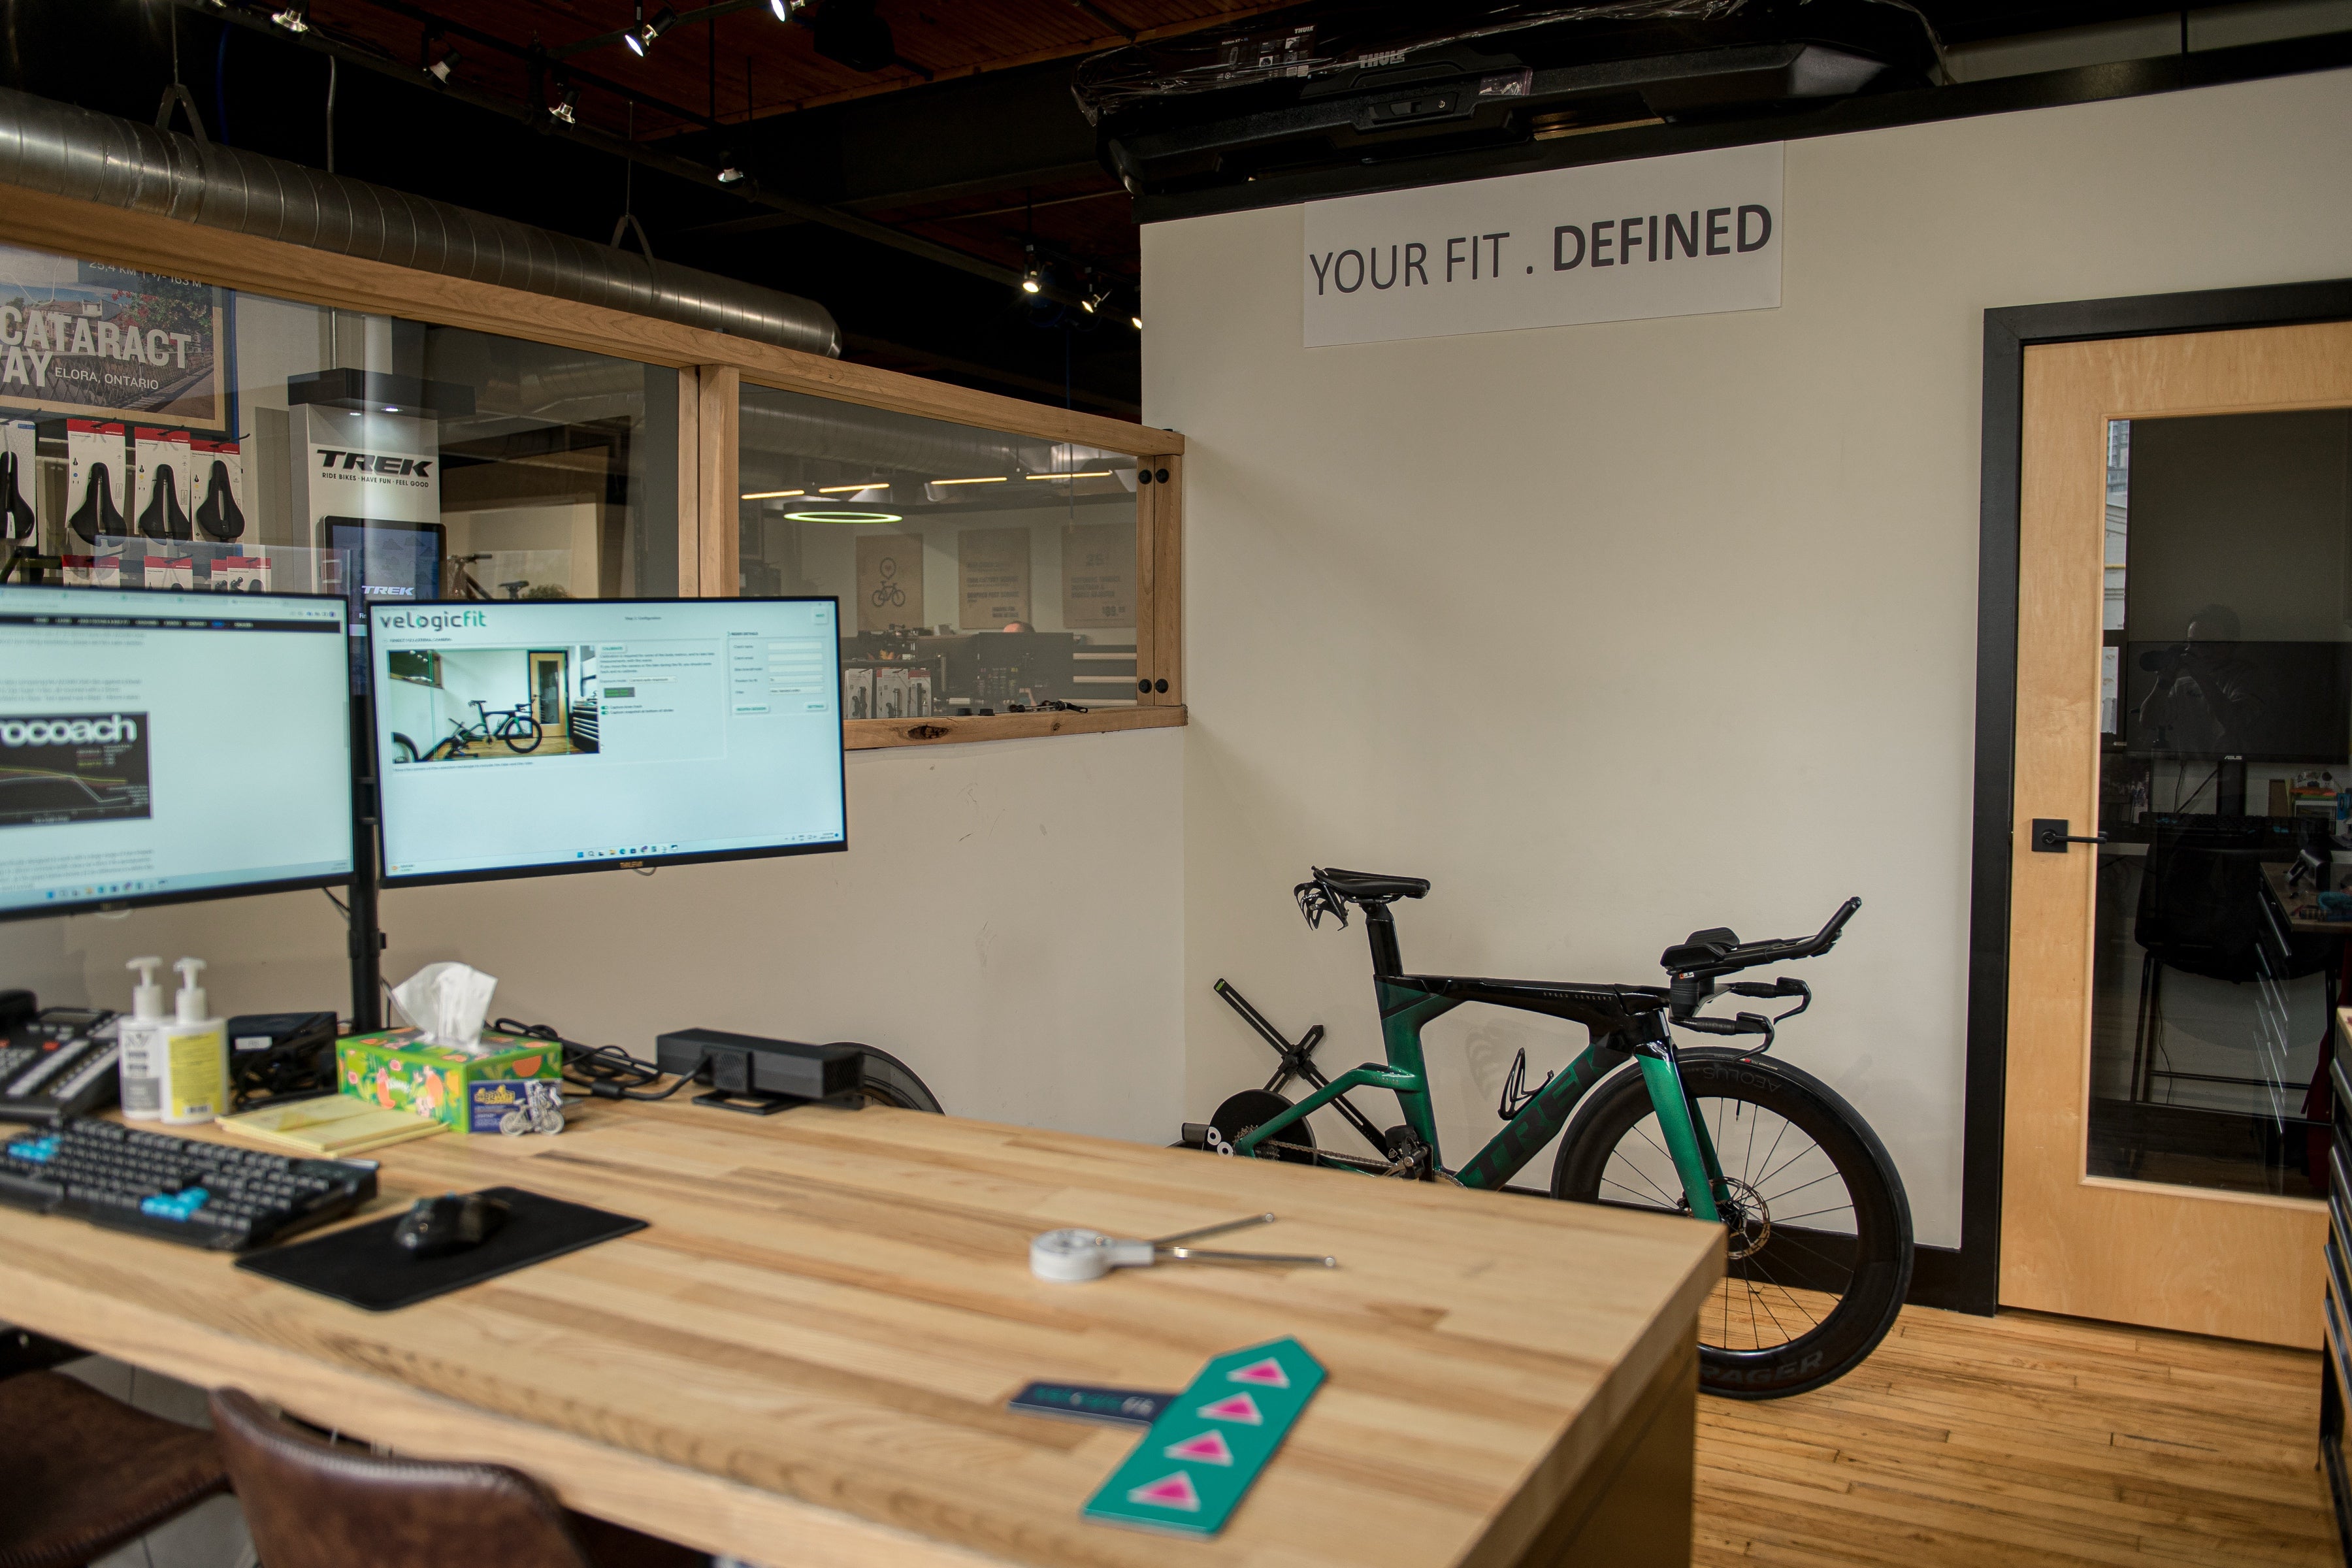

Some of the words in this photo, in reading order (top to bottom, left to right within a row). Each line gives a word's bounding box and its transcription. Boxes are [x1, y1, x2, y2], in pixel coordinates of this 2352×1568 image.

[1358, 50, 1405, 69] THULE
[1309, 242, 1429, 295] YOUR
[1445, 232, 1511, 282] FIT
[1552, 203, 1772, 271] DEFINED
[0, 306, 192, 369] CATARACT
[0, 344, 54, 387] AY
[55, 367, 101, 384] ELORA,
[105, 373, 159, 390] ONTARIO
[317, 449, 433, 478] TREK
[338, 473, 357, 482] BIKES
[361, 585, 414, 596] TREK
[380, 610, 487, 632] velogicfit
[1703, 1067, 1782, 1092] AEOLUS
[1465, 1045, 1627, 1185] TREK
